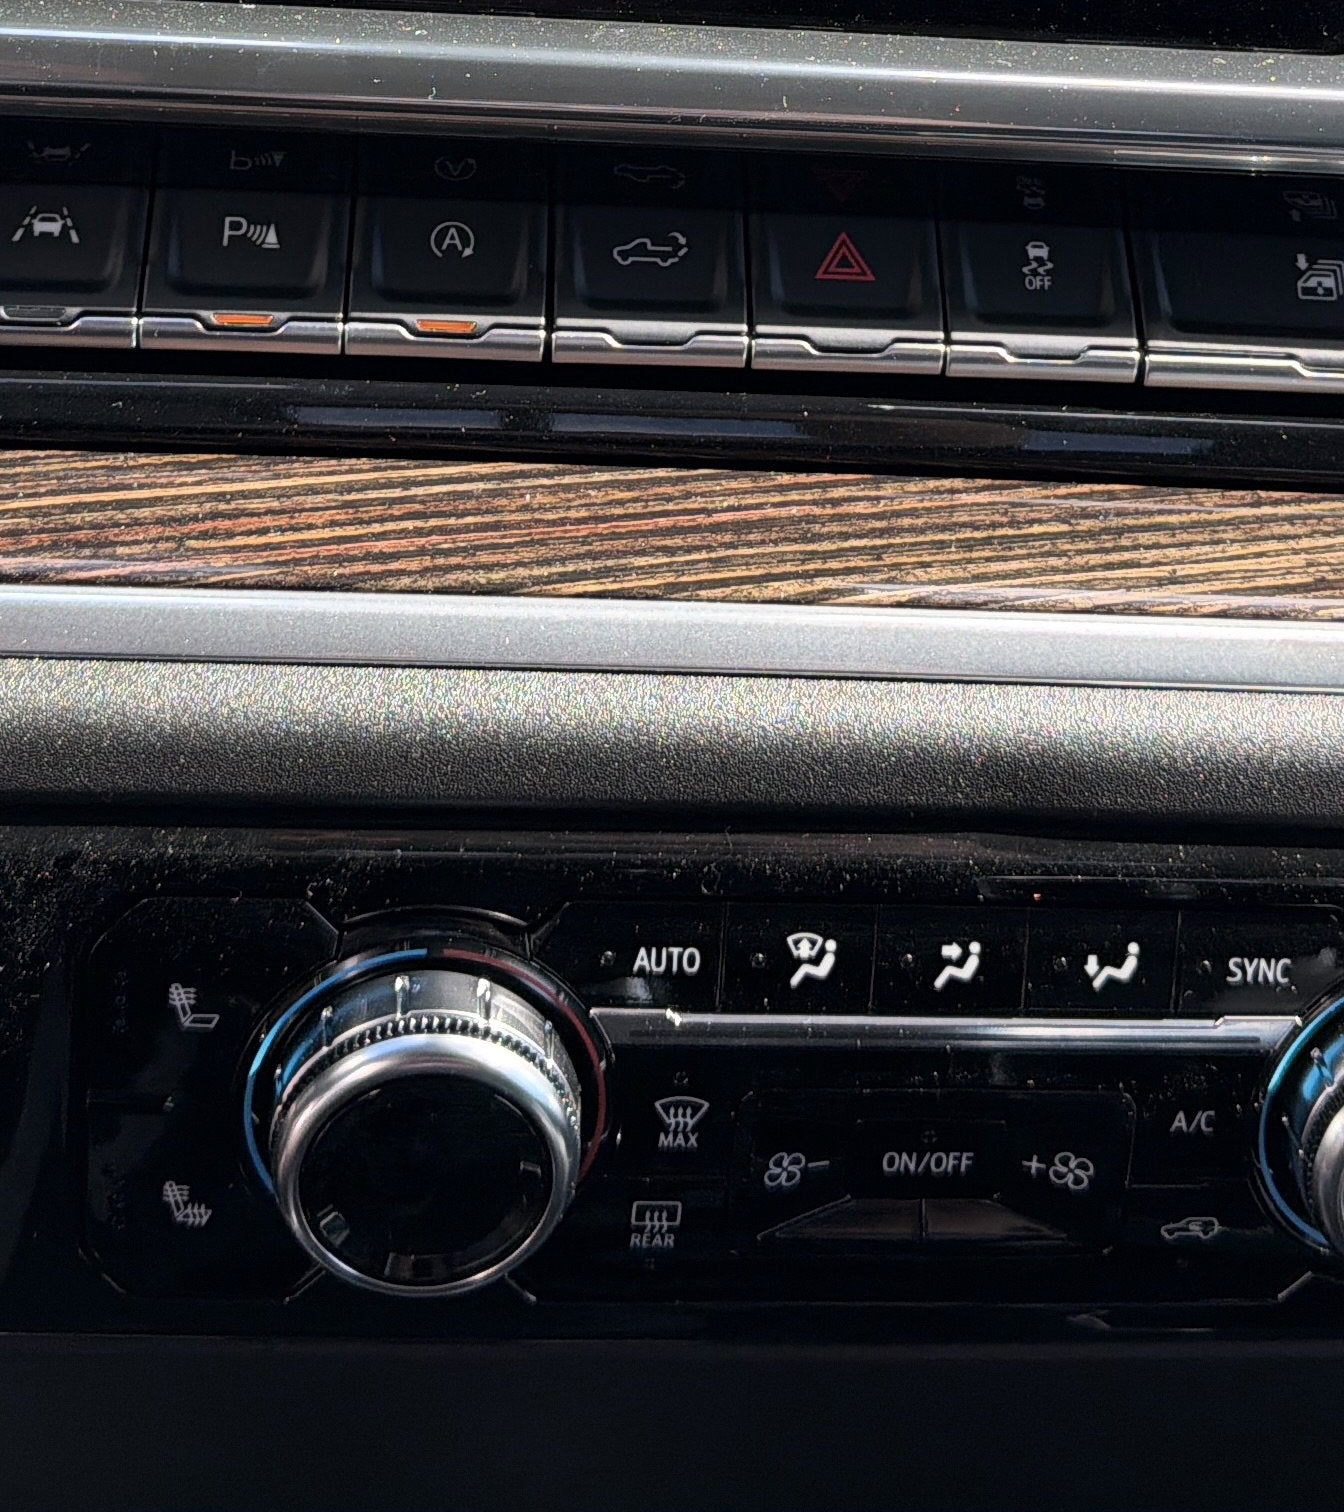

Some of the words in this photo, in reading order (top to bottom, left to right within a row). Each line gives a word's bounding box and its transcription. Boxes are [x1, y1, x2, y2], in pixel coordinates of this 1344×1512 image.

[1025, 276, 1053, 291] OFF
[633, 947, 701, 975] AUTO
[1227, 957, 1292, 985] SYNC
[1169, 1110, 1215, 1135] A/C
[659, 1132, 698, 1148] MAX
[882, 1151, 974, 1175] ON/OFF
[630, 1232, 675, 1249] REAR
